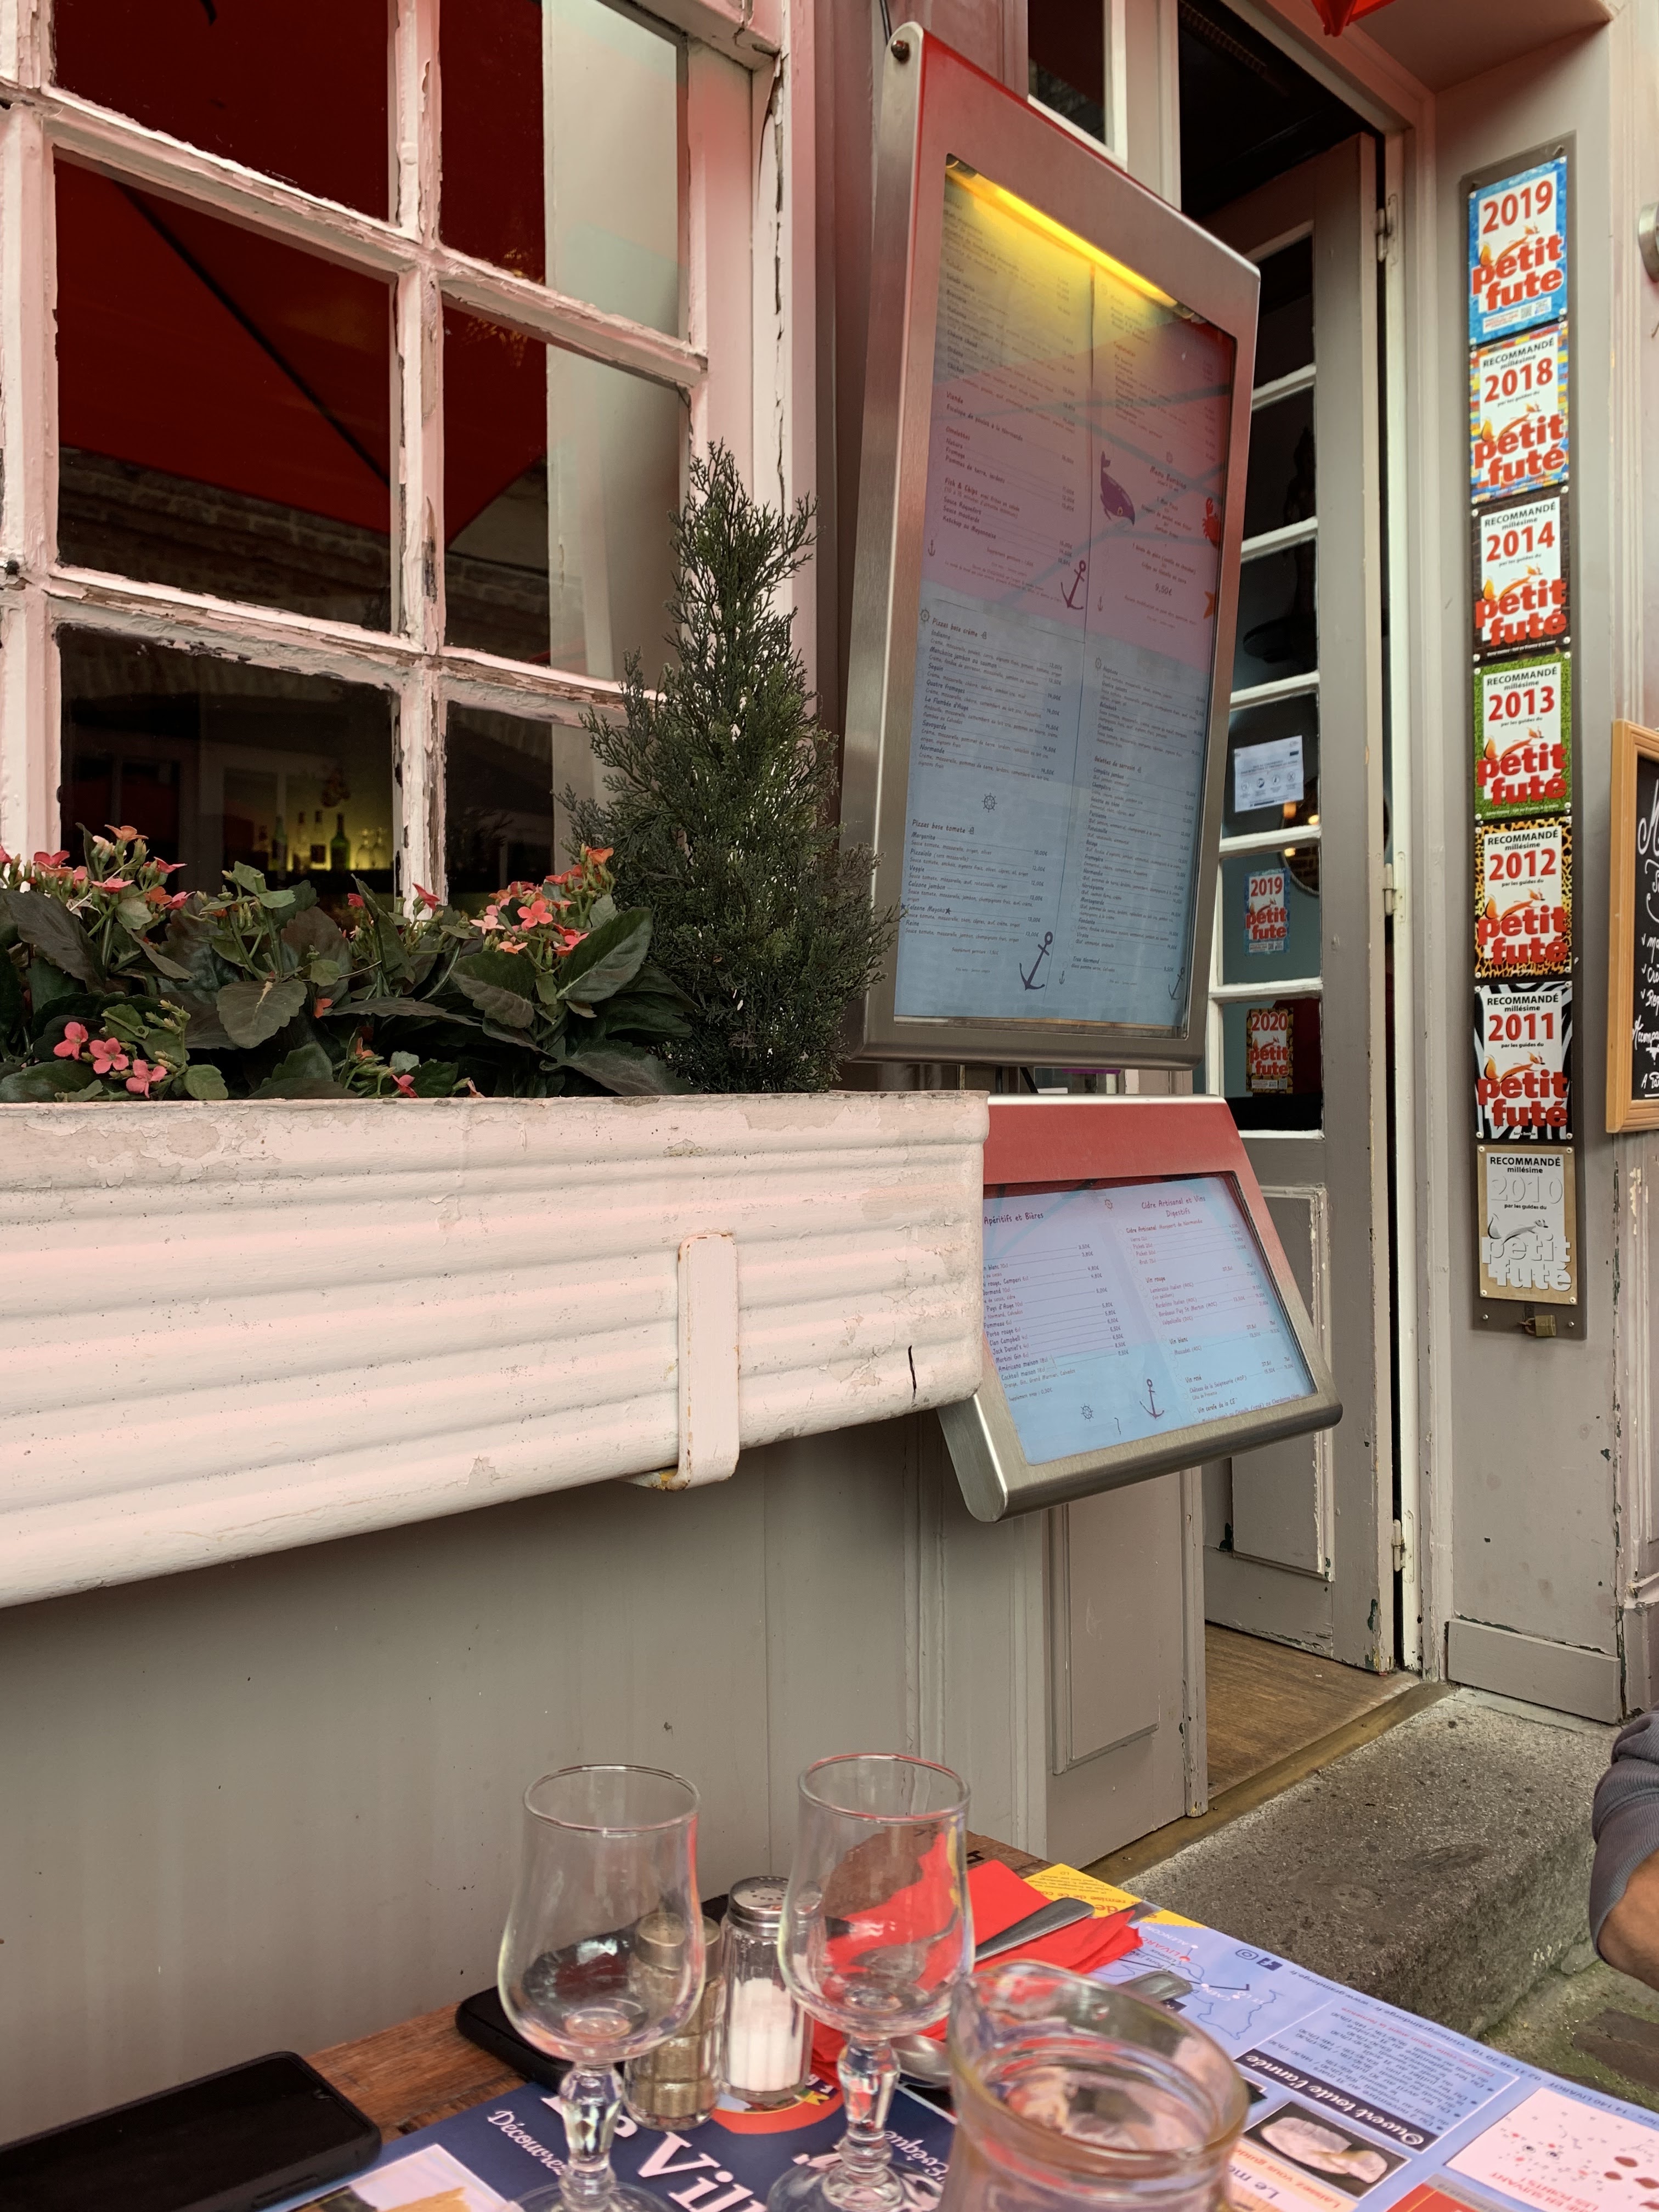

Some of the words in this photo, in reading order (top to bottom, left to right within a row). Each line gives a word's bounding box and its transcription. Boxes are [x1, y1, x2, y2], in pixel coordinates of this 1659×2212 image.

[1483, 180, 1553, 234] 2019
[1472, 234, 1562, 295] petit
[1483, 338, 1554, 368] RECOMMANDÉ
[1485, 358, 1553, 403] 2018
[1475, 414, 1563, 469] petit
[1489, 443, 1565, 486] futé
[1485, 502, 1555, 527] RECOMMANDÉ
[1502, 518, 1538, 530] millésime
[1487, 521, 1554, 562] 2014
[1476, 579, 1566, 629] petit
[932, 617, 949, 629] Pizzas
[951, 623, 961, 633] base
[1490, 608, 1566, 646] futé
[1487, 667, 1557, 686] RECOMMANDÉ
[1504, 680, 1539, 690] millésime
[1489, 686, 1554, 721] 2013
[1477, 743, 1566, 786] petit
[1492, 773, 1566, 805] futé
[911, 831, 935, 842] Margarita
[912, 819, 929, 828] Pizzas
[932, 822, 943, 830] base
[946, 825, 965, 834] tomate
[1488, 830, 1558, 845] RECOMMANDÉ
[1505, 843, 1540, 851] millésime
[909, 864, 924, 873] Veggie
[1489, 848, 1556, 880] 2012
[908, 879, 927, 888] Calzone
[928, 883, 945, 891] jambon
[1251, 877, 1283, 896] 2019
[1246, 906, 1287, 929] petit
[1479, 906, 1567, 945] petit
[1492, 936, 1567, 964] futé
[1488, 994, 1559, 1005] RECOMMANDÉ
[1251, 1013, 1288, 1031] 2020
[1489, 1013, 1554, 1041] 2011
[1250, 1046, 1289, 1064] petit
[1478, 1069, 1567, 1105] petit
[1492, 1099, 1567, 1127] futé
[1491, 1157, 1560, 1166] RECOMMANDÉ
[1140, 1200, 1156, 1209] Cidre
[1156, 1197, 1184, 1206] Artisanal
[1491, 1176, 1563, 1204] 2010
[982, 1214, 1013, 1227] Apéritifs
[1024, 1210, 1044, 1220] Bières
[1165, 1207, 1192, 1218] Digestifs
[1482, 1233, 1571, 1264] petit
[1497, 1260, 1572, 1291] futé
[1246, 2055, 1309, 2089] l'année
[1307, 2085, 1356, 2112] toute
[1356, 2108, 1424, 2145] Ouvert
